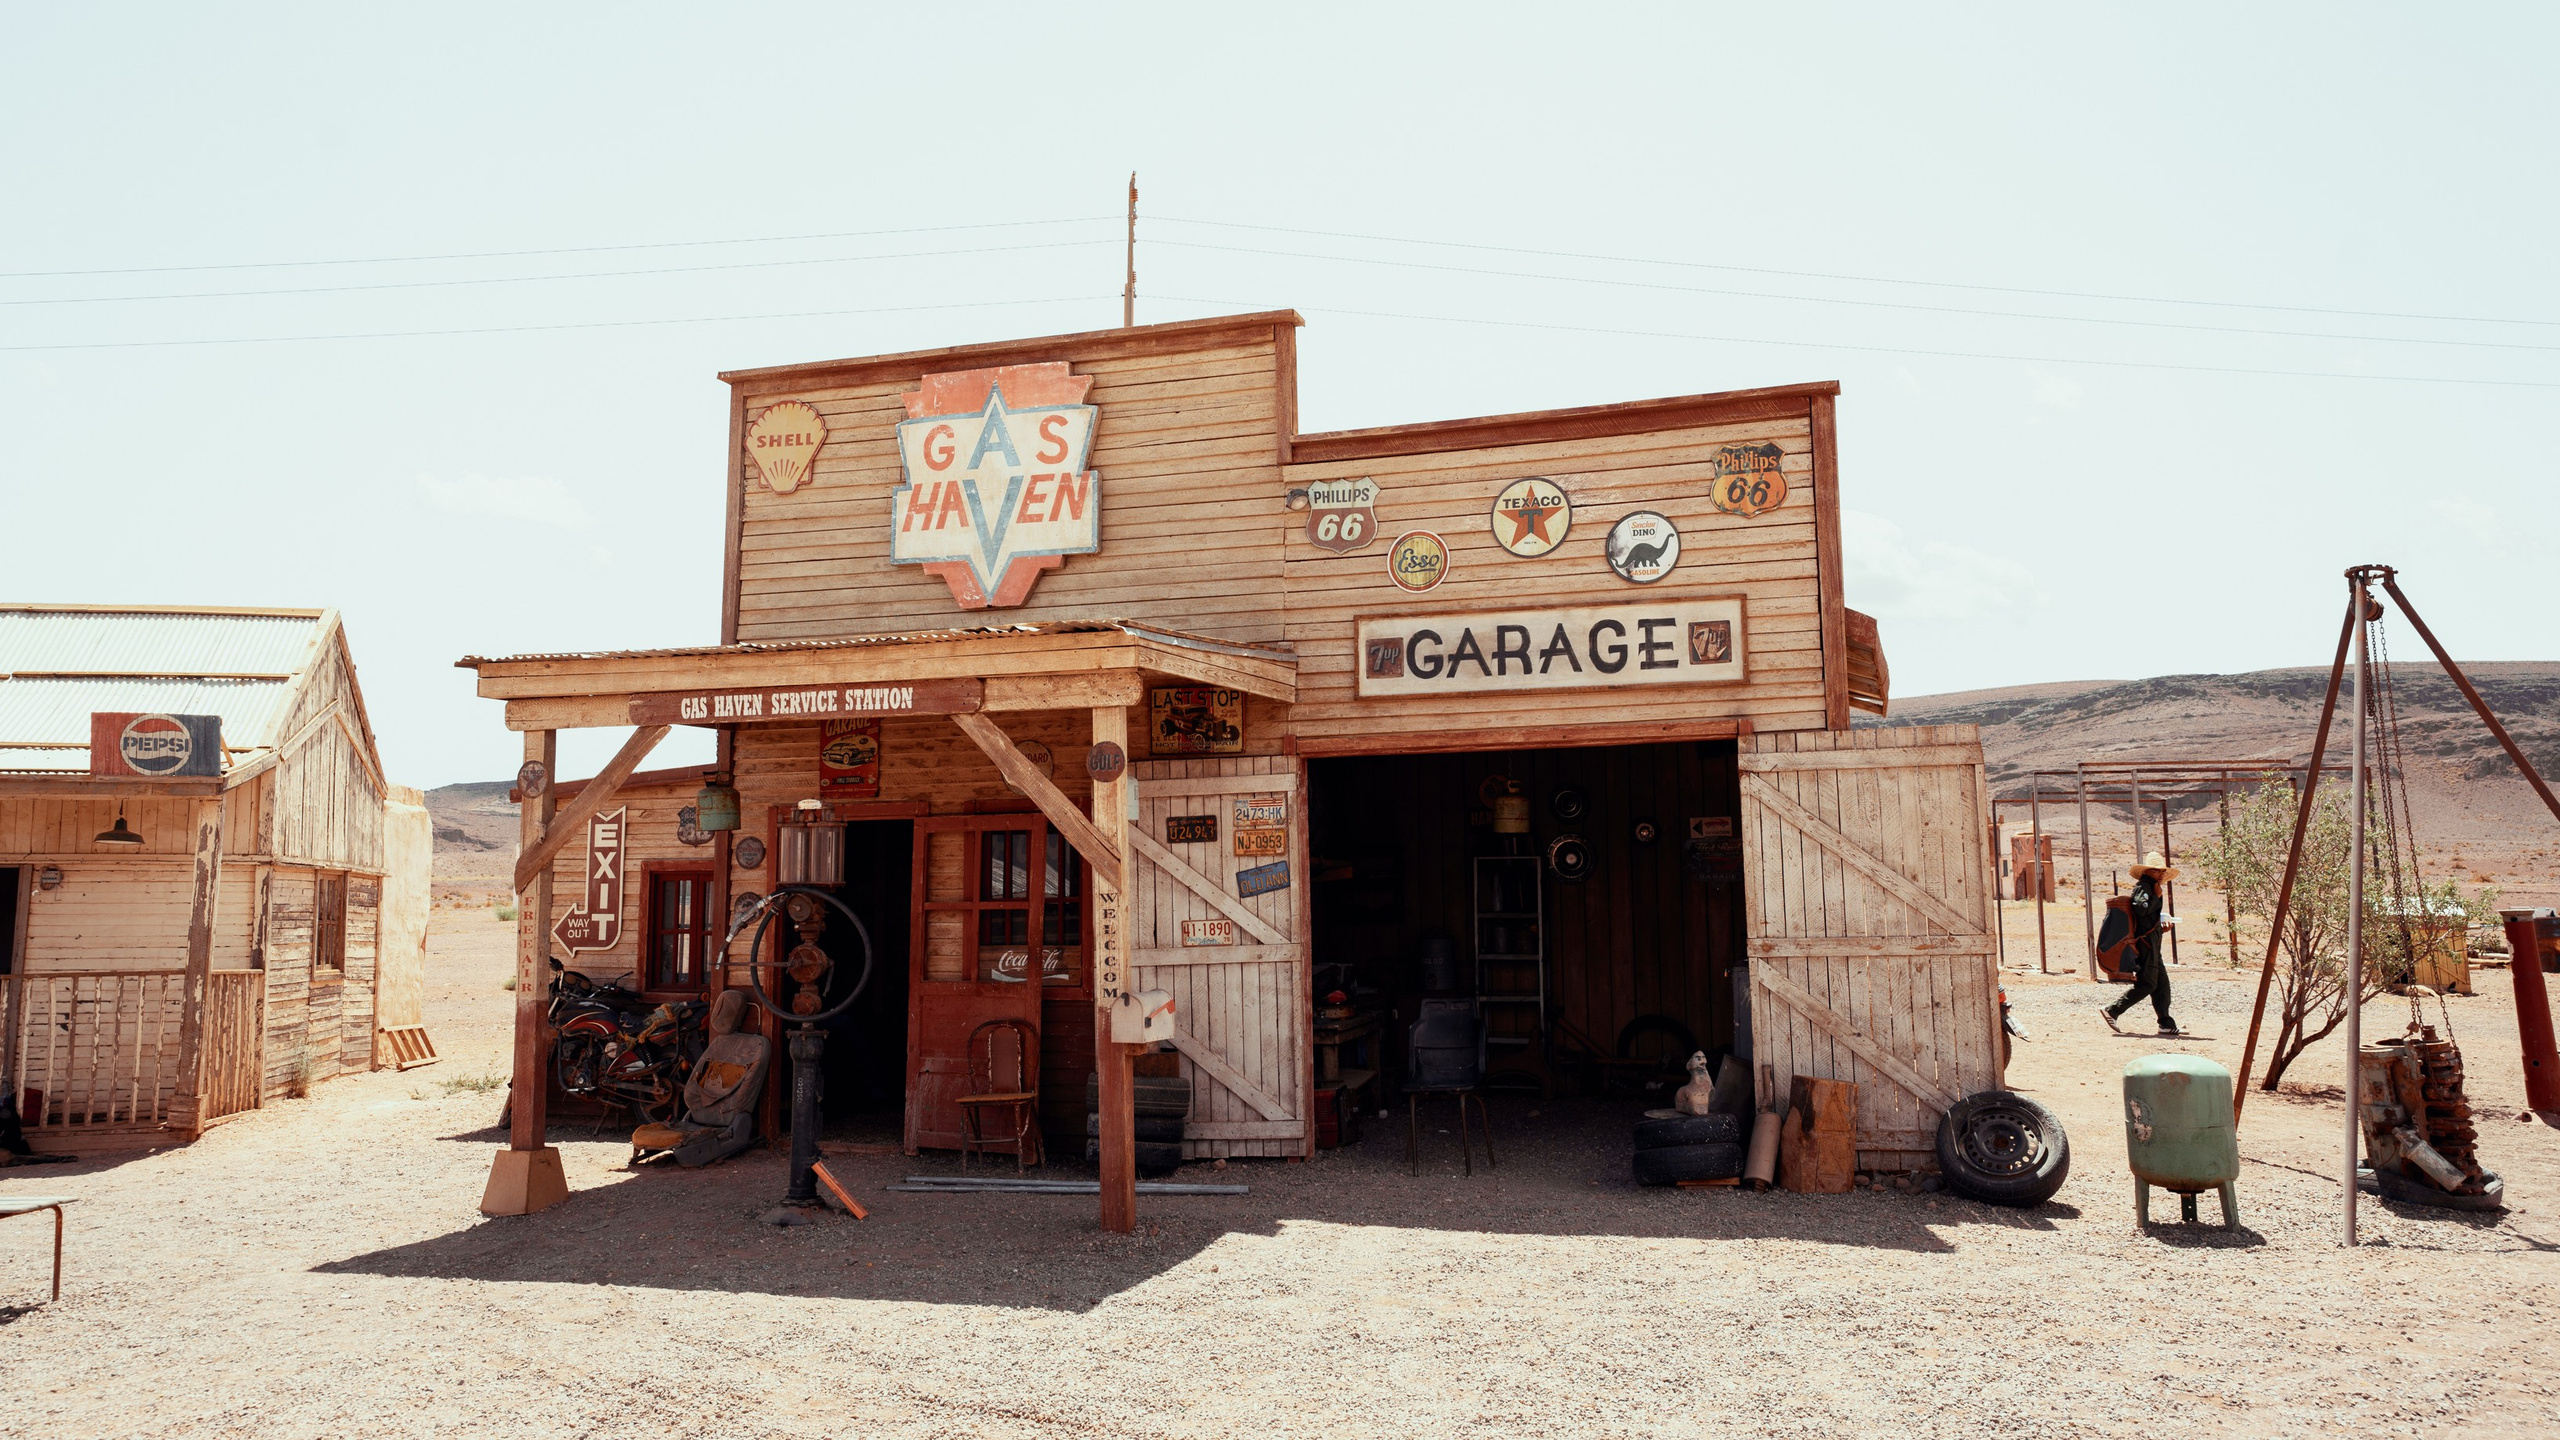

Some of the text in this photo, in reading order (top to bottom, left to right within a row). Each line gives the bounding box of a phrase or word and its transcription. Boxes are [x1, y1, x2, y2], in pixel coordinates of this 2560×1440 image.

[757, 432, 815, 449] SHELL
[923, 403, 1069, 471] GAS
[1719, 452, 1779, 472] Phillips
[1313, 487, 1370, 504] PHILLIPS
[1727, 476, 1771, 507] 66
[1503, 495, 1562, 509] TEXACO
[902, 471, 1092, 577] HAVEN
[1317, 513, 1365, 541] 66
[1632, 529, 1656, 537] DINO
[1397, 548, 1440, 574] Esso
[1630, 568, 1660, 576] GASOLINE
[1405, 617, 1680, 680] GARAGE
[681, 687, 913, 719] GAS HAVEN SERVICE STATION
[1153, 689, 1240, 709] LAST STOP
[123, 736, 189, 753] PEPSI
[1025, 752, 1049, 763] DARD
[1089, 754, 1120, 771] GULF
[591, 823, 619, 941] EXIT
[1240, 877, 1264, 894] OLD
[1266, 870, 1289, 888] ANN
[567, 918, 590, 928] WAY
[567, 929, 590, 939] OUT
